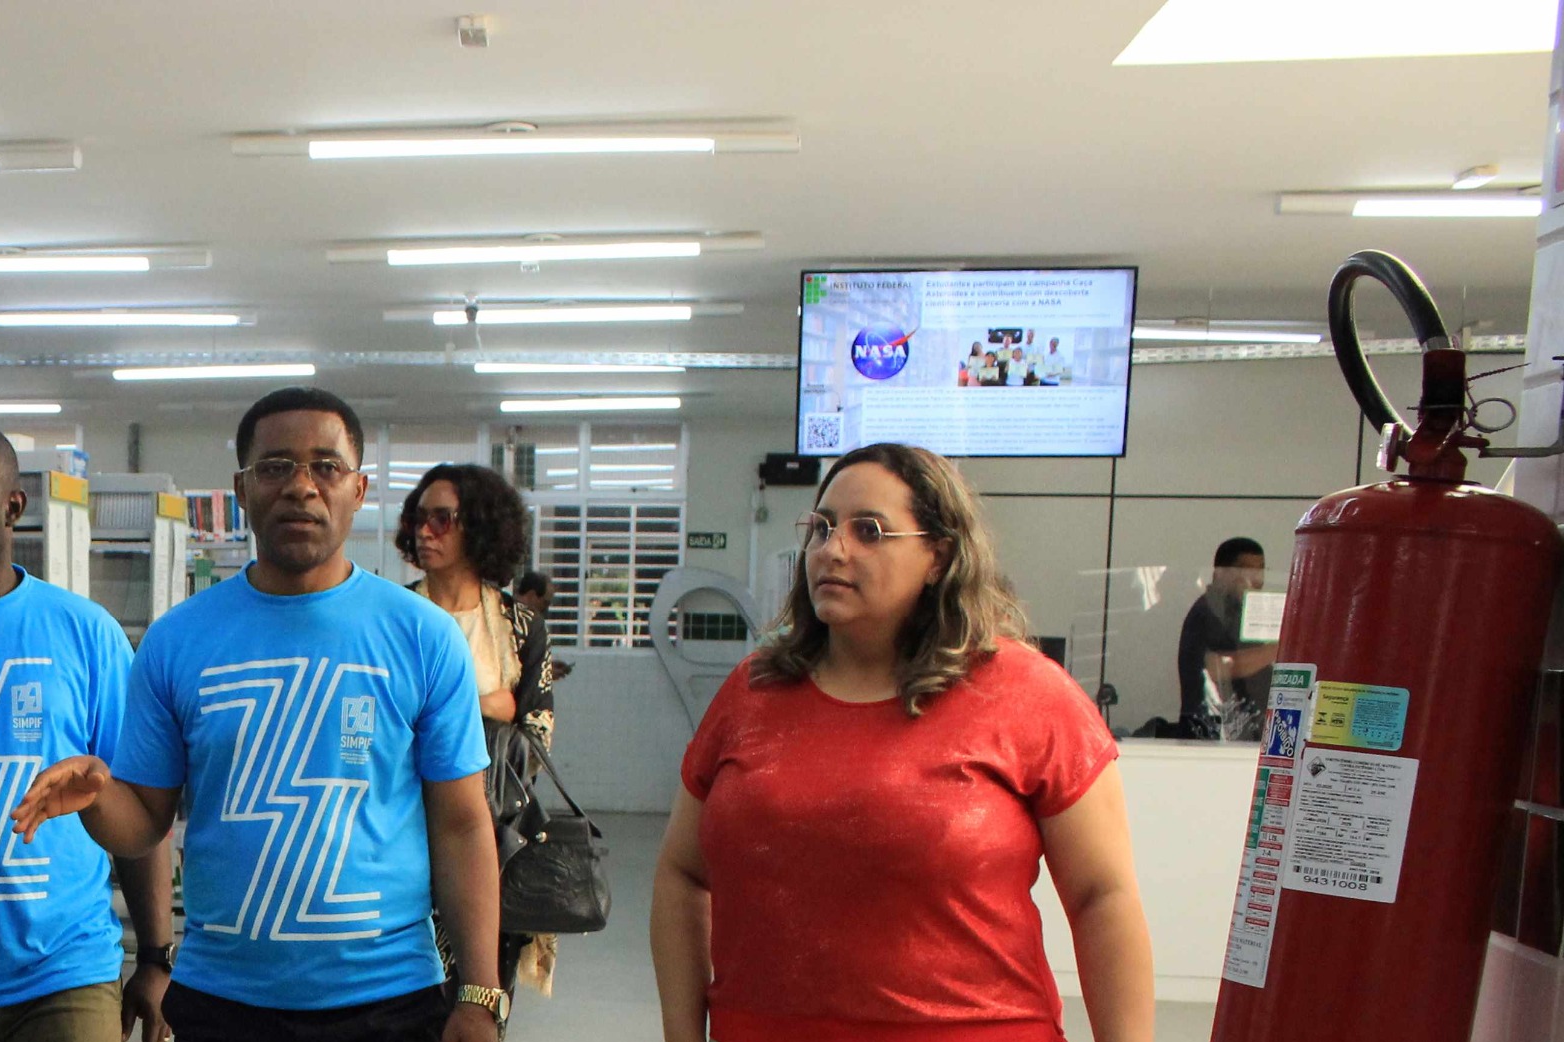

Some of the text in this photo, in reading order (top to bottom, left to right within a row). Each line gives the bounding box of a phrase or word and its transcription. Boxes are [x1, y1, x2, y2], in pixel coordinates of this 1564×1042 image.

[876, 281, 913, 289] FEDERAL
[973, 279, 1016, 288] participam
[1029, 278, 1071, 288] campanha
[977, 289, 1023, 297] contribuem
[1038, 298, 1063, 306] NASA
[855, 344, 907, 359] NASA
[1322, 693, 1350, 702] Segurança
[12, 717, 44, 729] SIMPIF
[1274, 710, 1295, 757] PROIBIDO
[340, 735, 374, 750] SIMPIF
[1303, 875, 1368, 891] 9431008
